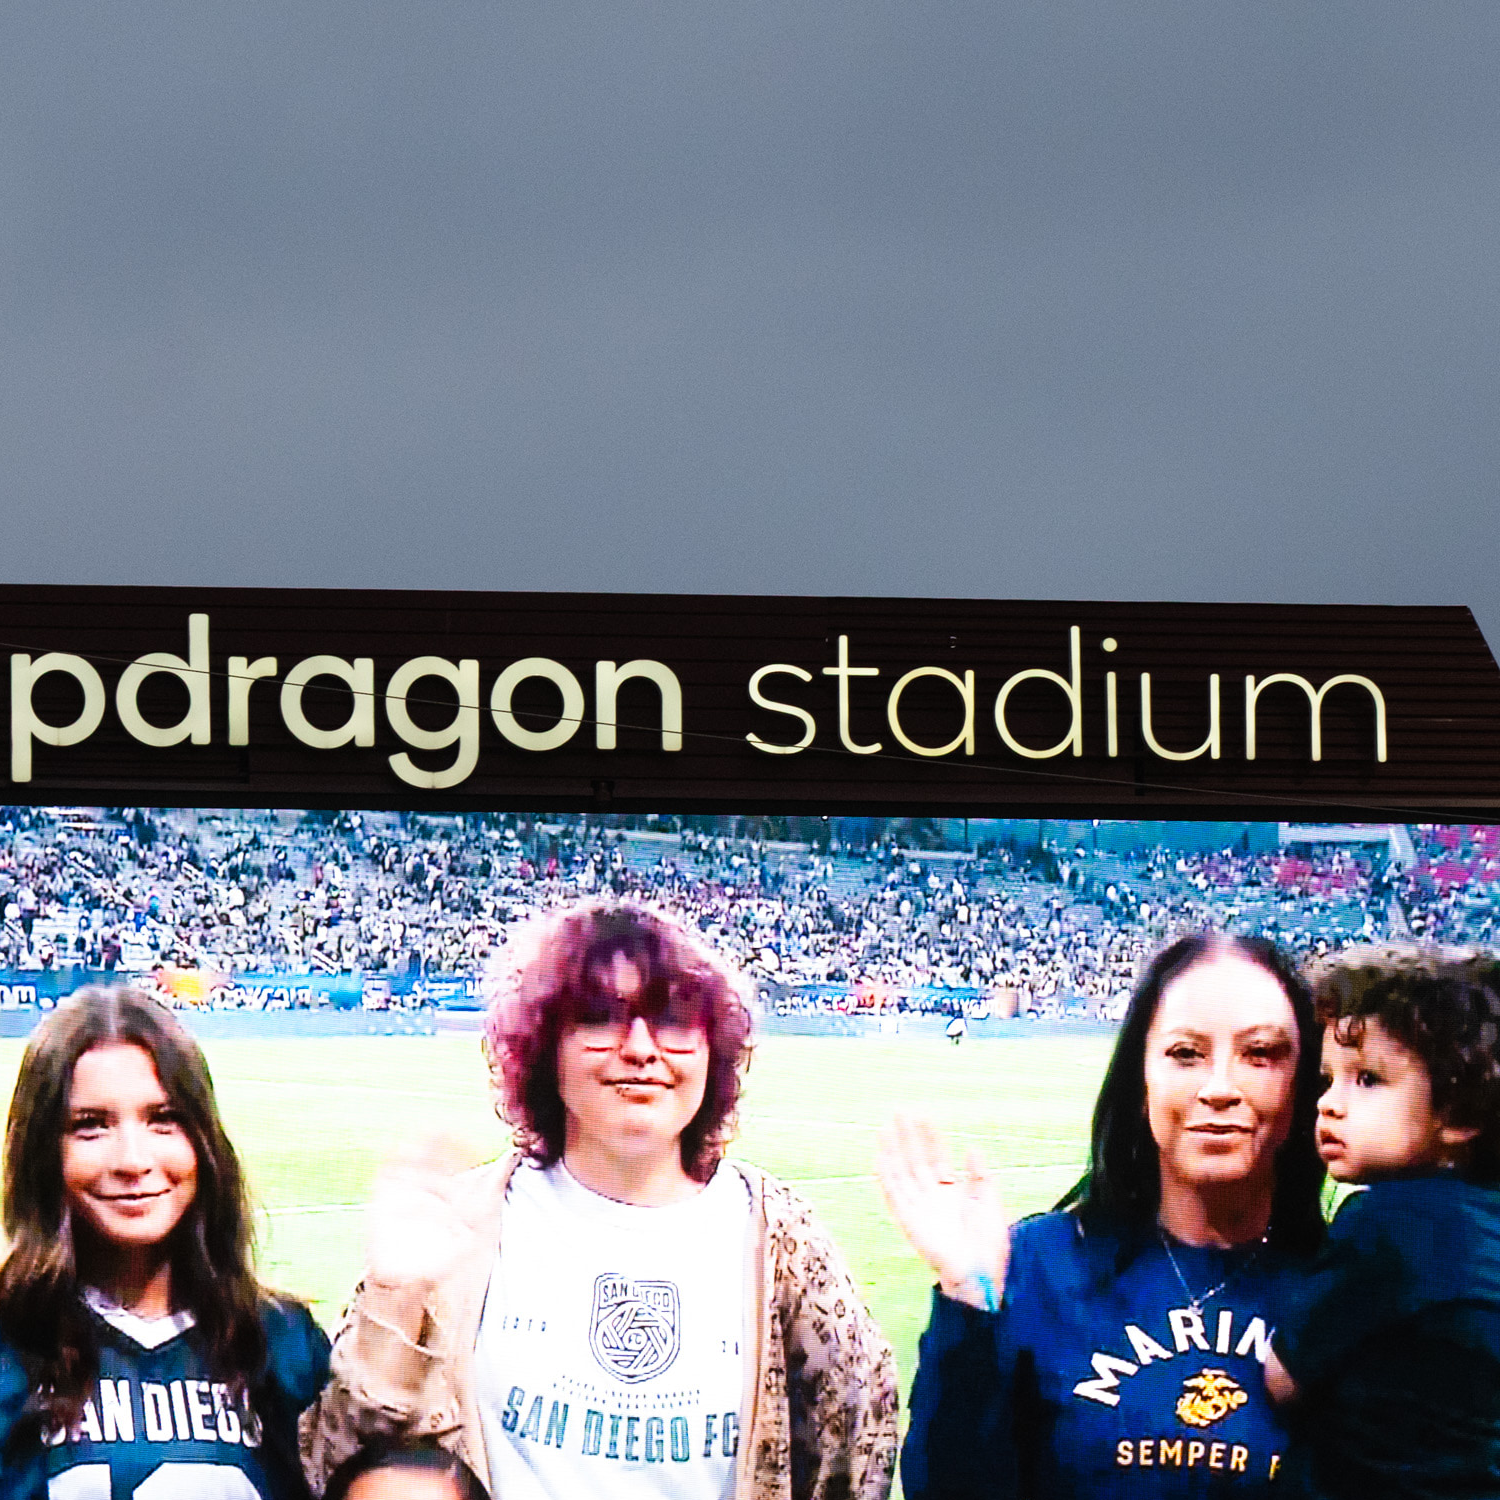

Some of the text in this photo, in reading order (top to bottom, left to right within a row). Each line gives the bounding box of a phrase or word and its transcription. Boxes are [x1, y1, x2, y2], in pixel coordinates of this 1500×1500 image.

[746, 624, 1389, 765] stadium
[39, 1379, 135, 1447] AN
[502, 1385, 569, 1449] SAN
[581, 1408, 690, 1463] DIEGO
[1116, 1439, 1249, 1472] SEMPER
